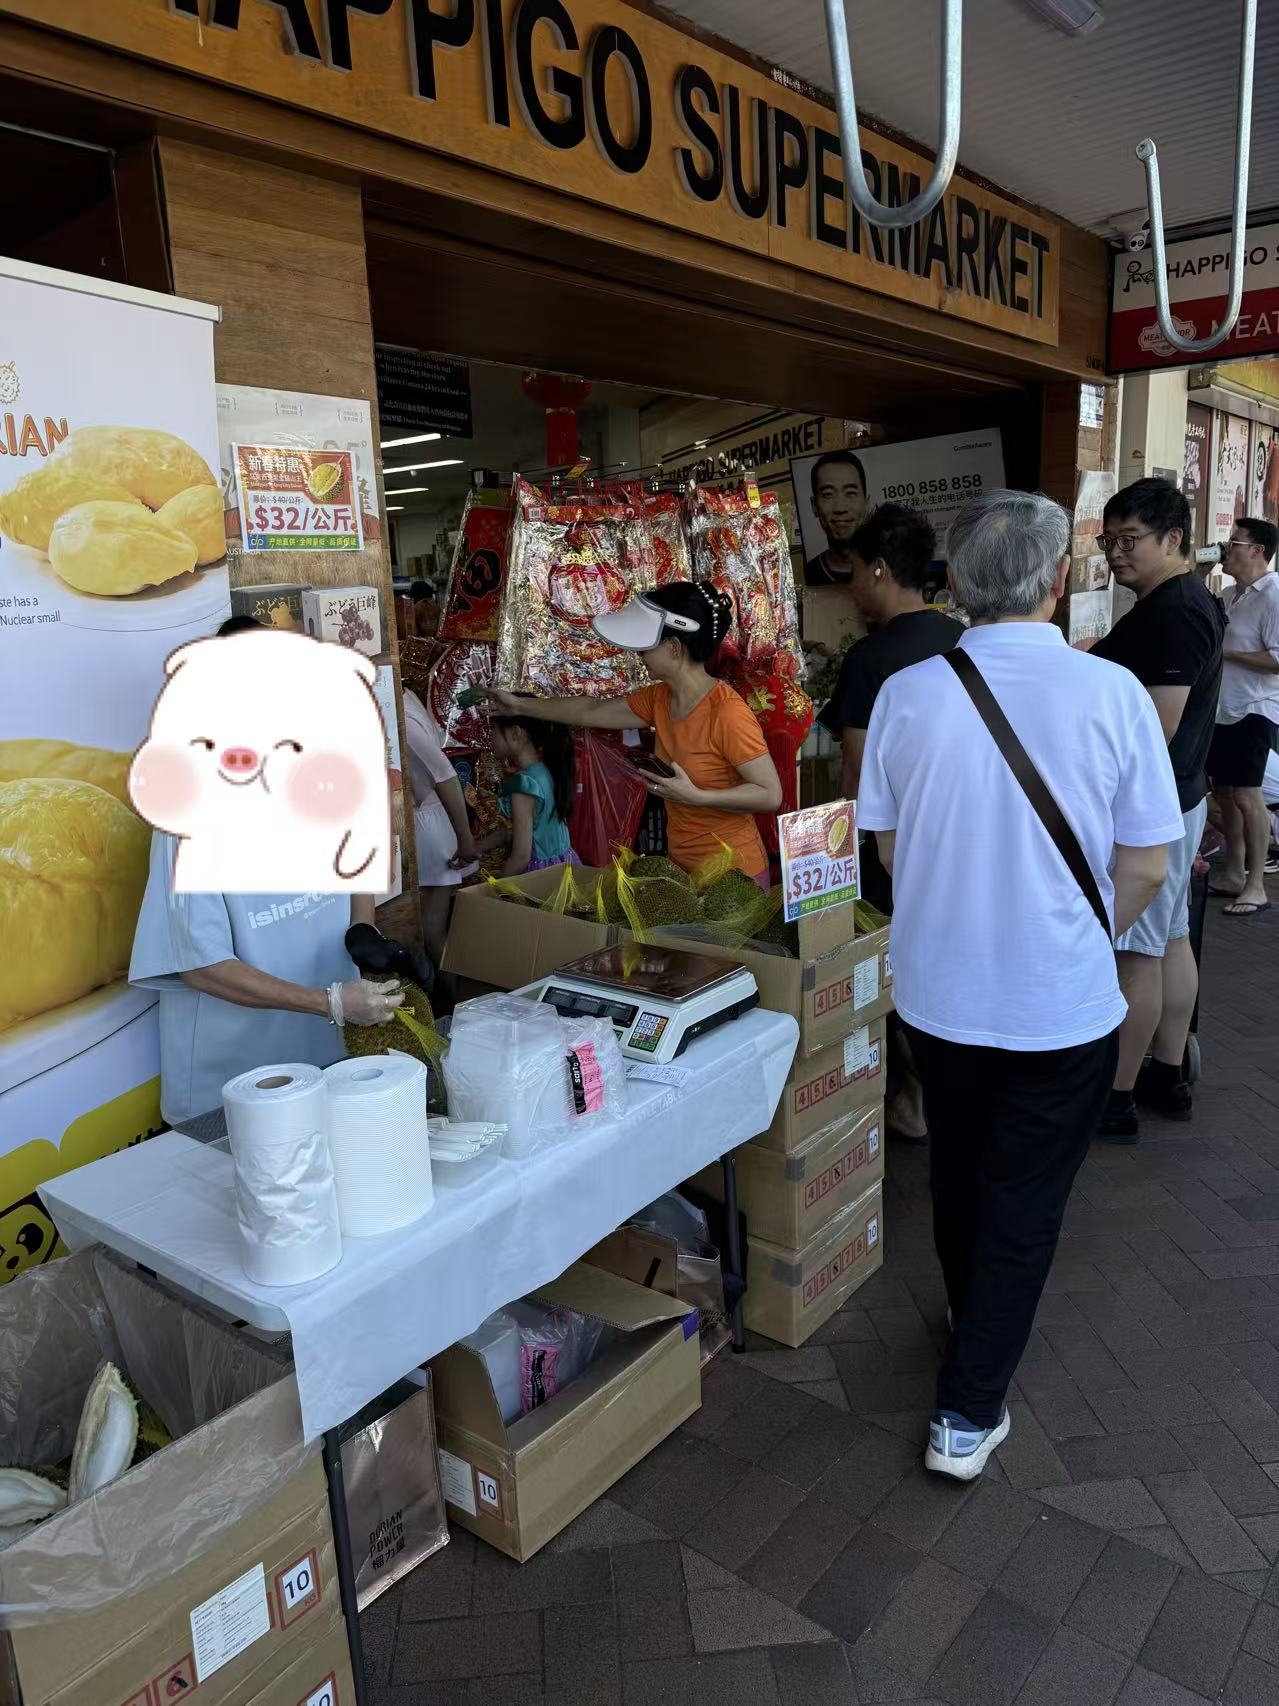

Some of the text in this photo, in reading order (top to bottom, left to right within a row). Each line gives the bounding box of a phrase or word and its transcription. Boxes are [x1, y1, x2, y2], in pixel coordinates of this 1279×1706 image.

[168, 0, 1050, 320] PIGO SUPERMARKET
[1167, 246, 1268, 281] HAPPIO
[718, 417, 826, 478] SUPERMARKET
[248, 455, 301, 473] 新春特惠
[882, 473, 983, 499] 1800 858 858
[254, 504, 353, 532] $32/公斤
[13, 595, 31, 608] has
[32, 597, 39, 607] a
[0, 609, 62, 627] Nuclear small
[792, 858, 855, 898] $32/公斤
[816, 993, 825, 1010] 4
[831, 988, 839, 1004] 5
[869, 1049, 879, 1066] 10
[798, 1089, 807, 1107] 4
[814, 1084, 821, 1099] 5
[807, 1184, 816, 1201] 4
[820, 1176, 828, 1192] 5
[869, 1132, 878, 1148] 10
[819, 1272, 827, 1287] 5
[868, 1224, 877, 1240] 10
[479, 1479, 497, 1501] 10
[369, 1525, 404, 1557] POWER
[284, 1569, 310, 1600] 10
[310, 1693, 331, 1706] 0
